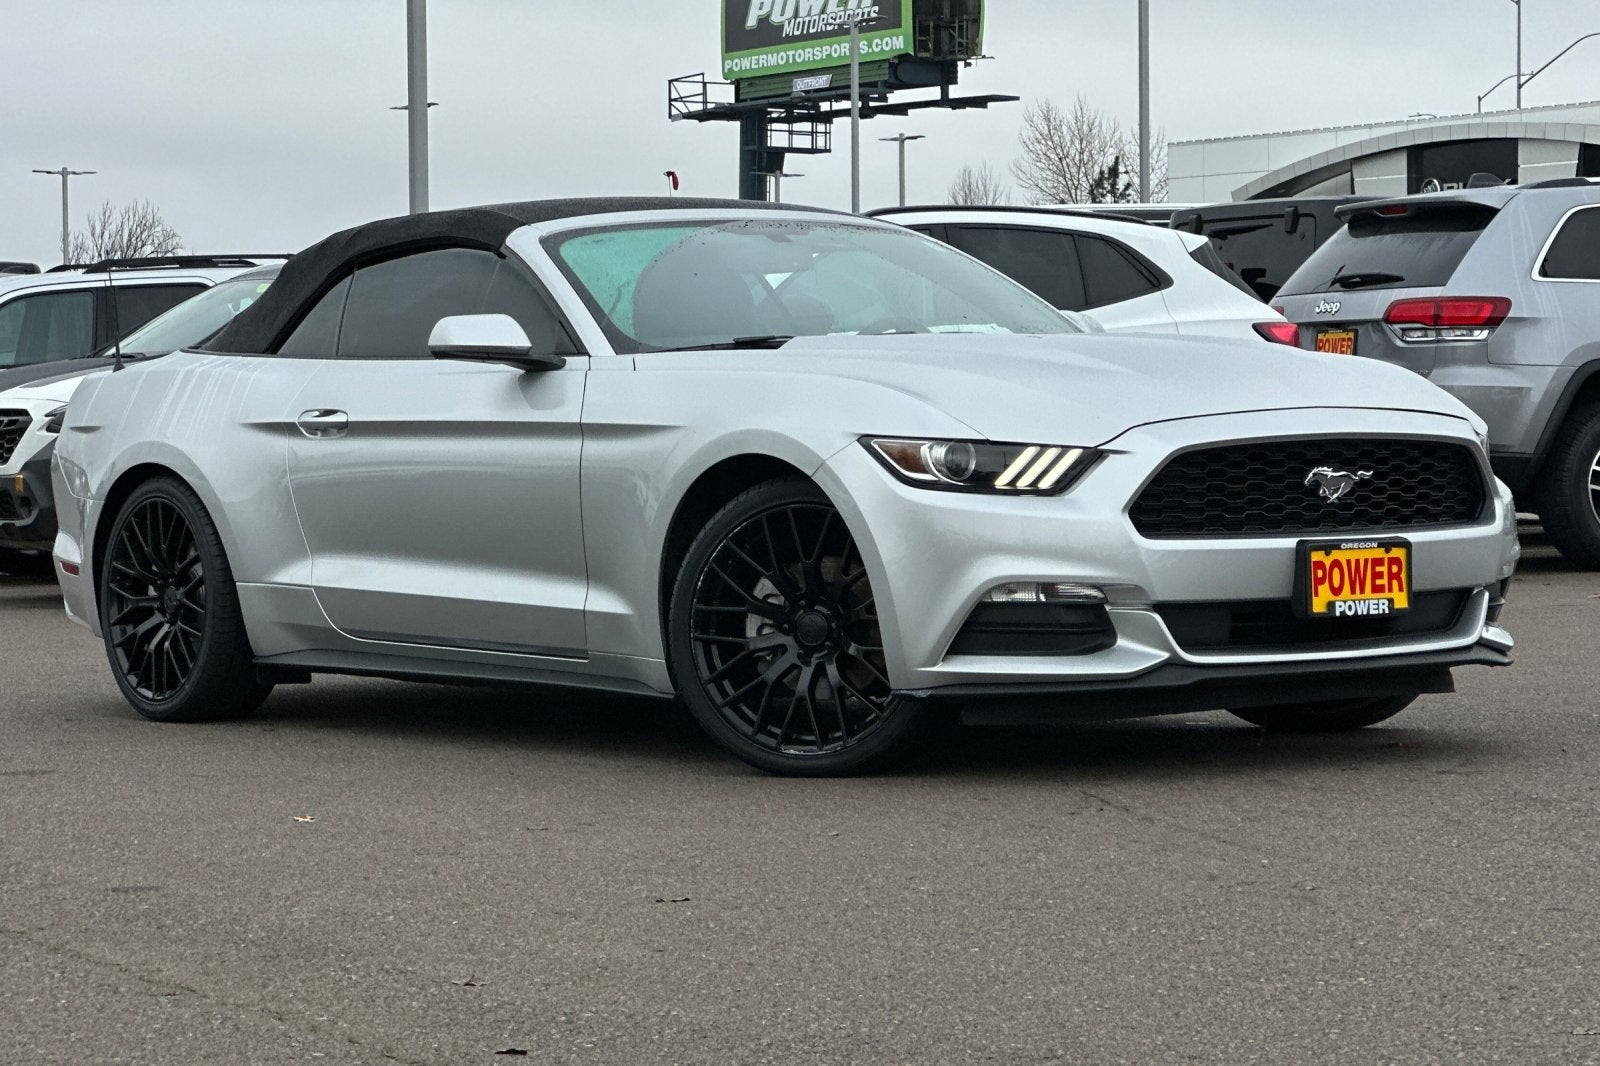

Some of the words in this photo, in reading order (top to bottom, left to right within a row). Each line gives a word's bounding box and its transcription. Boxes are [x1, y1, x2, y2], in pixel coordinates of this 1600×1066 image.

[745, 0, 874, 29] POW
[724, 35, 904, 73] POWERMOTORSPORS.COM
[1315, 300, 1341, 314] Jeep
[1318, 337, 1352, 355] POWER
[1312, 557, 1404, 597] POWER
[1335, 599, 1389, 616] POWER
